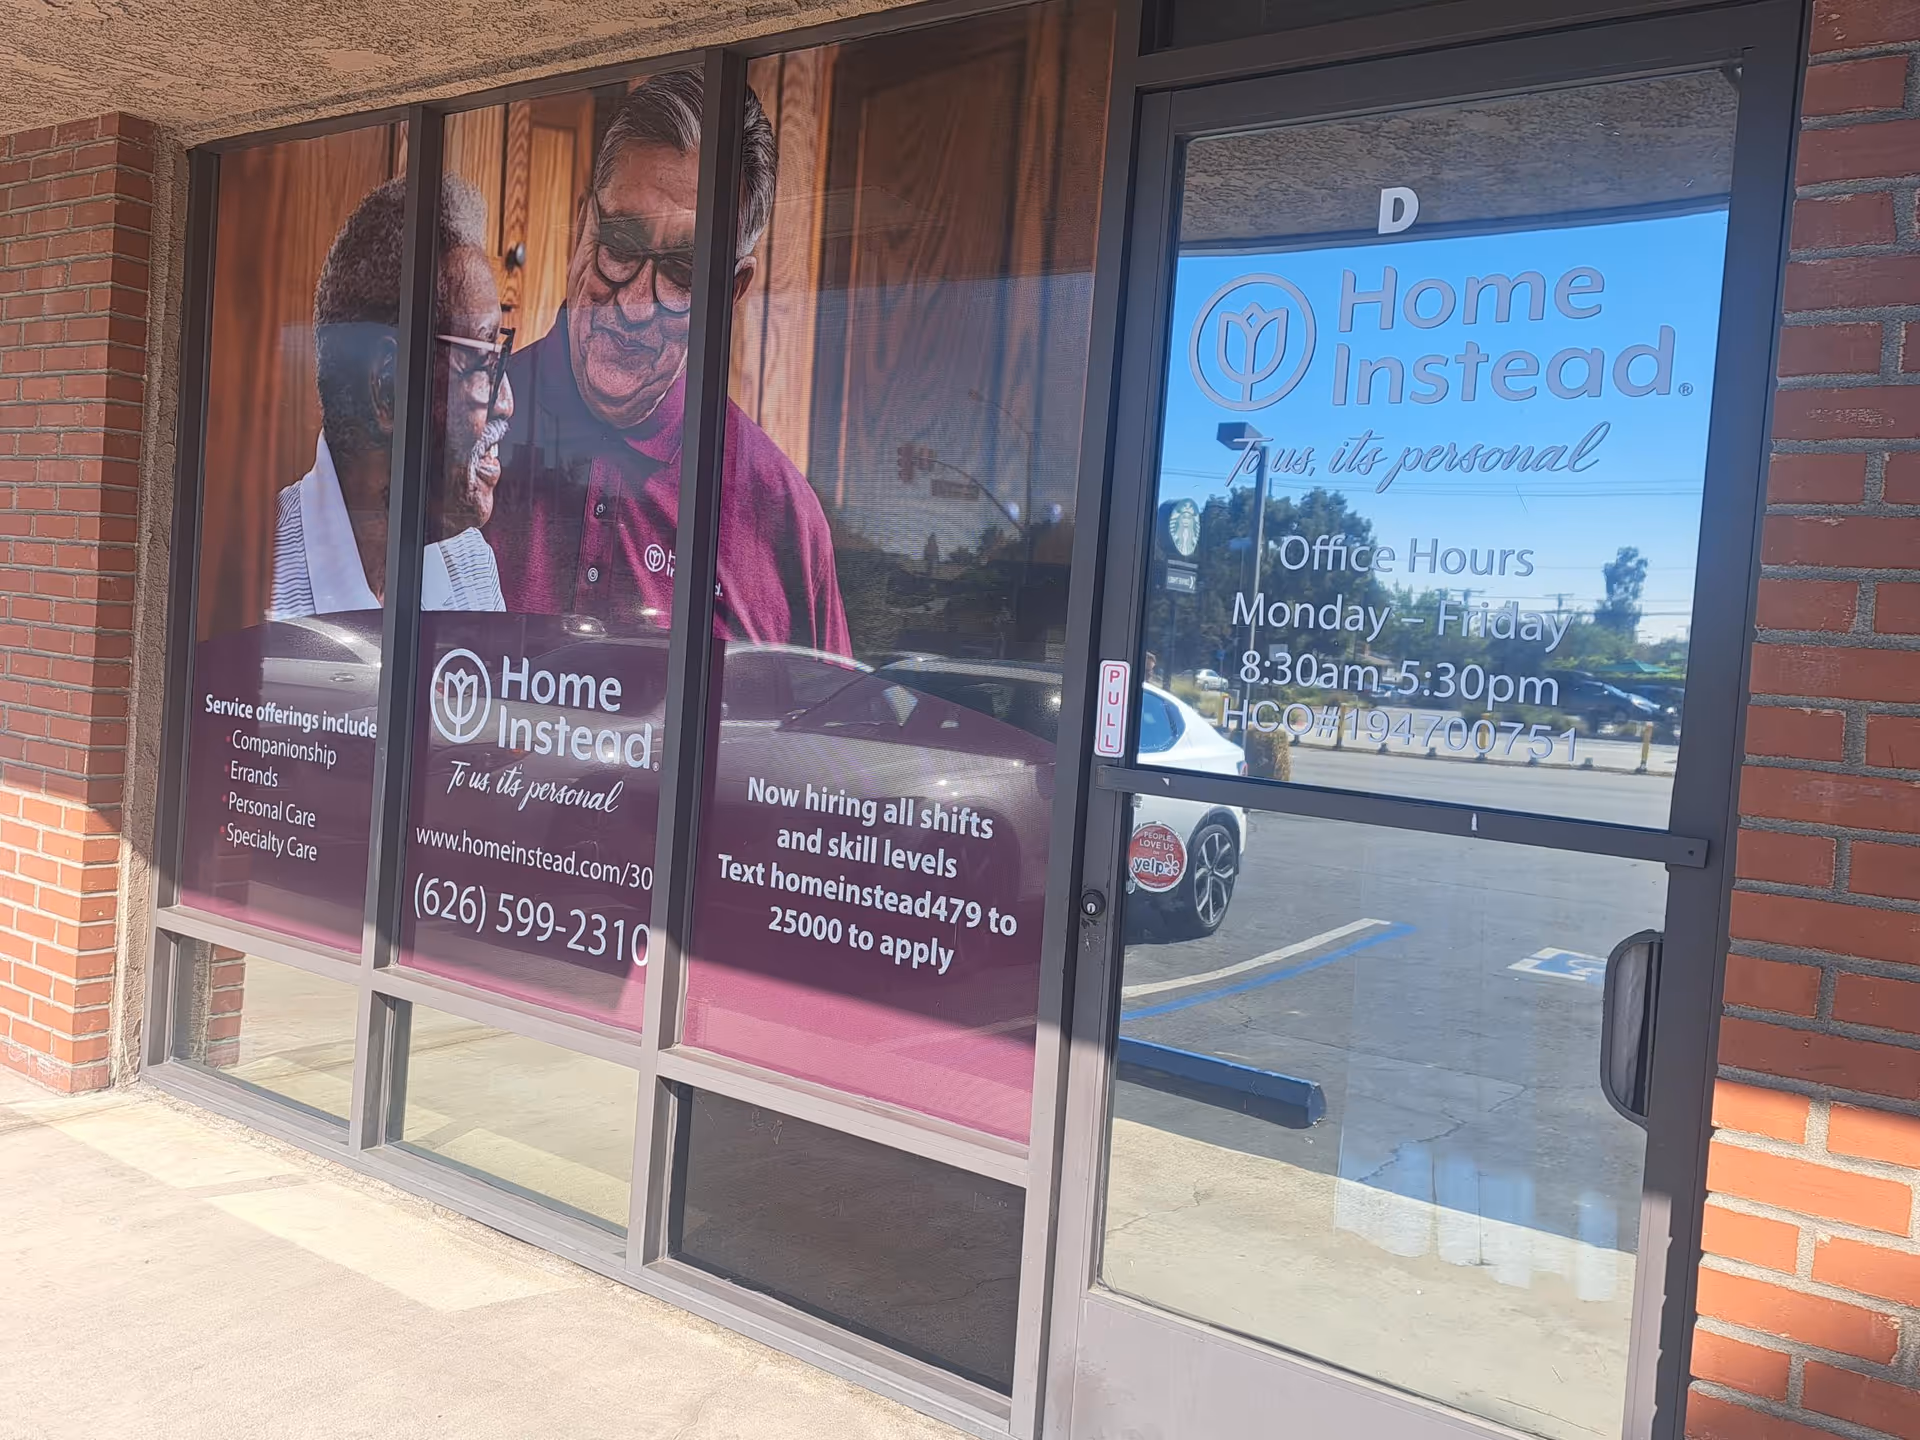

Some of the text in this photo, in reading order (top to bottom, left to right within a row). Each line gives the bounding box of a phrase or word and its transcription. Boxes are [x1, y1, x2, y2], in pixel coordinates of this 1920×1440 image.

[1377, 186, 1420, 235] D
[1338, 266, 1605, 333] Home
[1225, 437, 1274, 488] To
[1270, 446, 1316, 477] us,
[1376, 420, 1612, 494] personal
[1280, 535, 1535, 577] Office Hours
[1232, 591, 1392, 643] Monday
[1438, 600, 1574, 653] Friday
[501, 655, 622, 712] Home
[1105, 670, 1120, 748] PULL
[205, 693, 378, 739] Service offerings include
[1222, 697, 1577, 763] HCO#194700751
[230, 760, 278, 788] Errands
[232, 729, 337, 769] Companionship
[228, 791, 316, 828] Personal Care
[447, 760, 624, 813] To us, it's personal
[747, 776, 994, 840] Now hiring all shifts
[226, 822, 318, 861] Specialty Care
[416, 827, 653, 891] www.homeinstead.com/30
[776, 827, 958, 879] and skill levels
[1139, 838, 1174, 851] LOVE US
[1144, 831, 1171, 841] PEOPLE
[1133, 857, 1165, 877] yelp
[414, 872, 650, 967] (626) 599-2310
[718, 853, 1018, 937] Text homeinstead479 to
[768, 905, 955, 976] 25000 to apply
